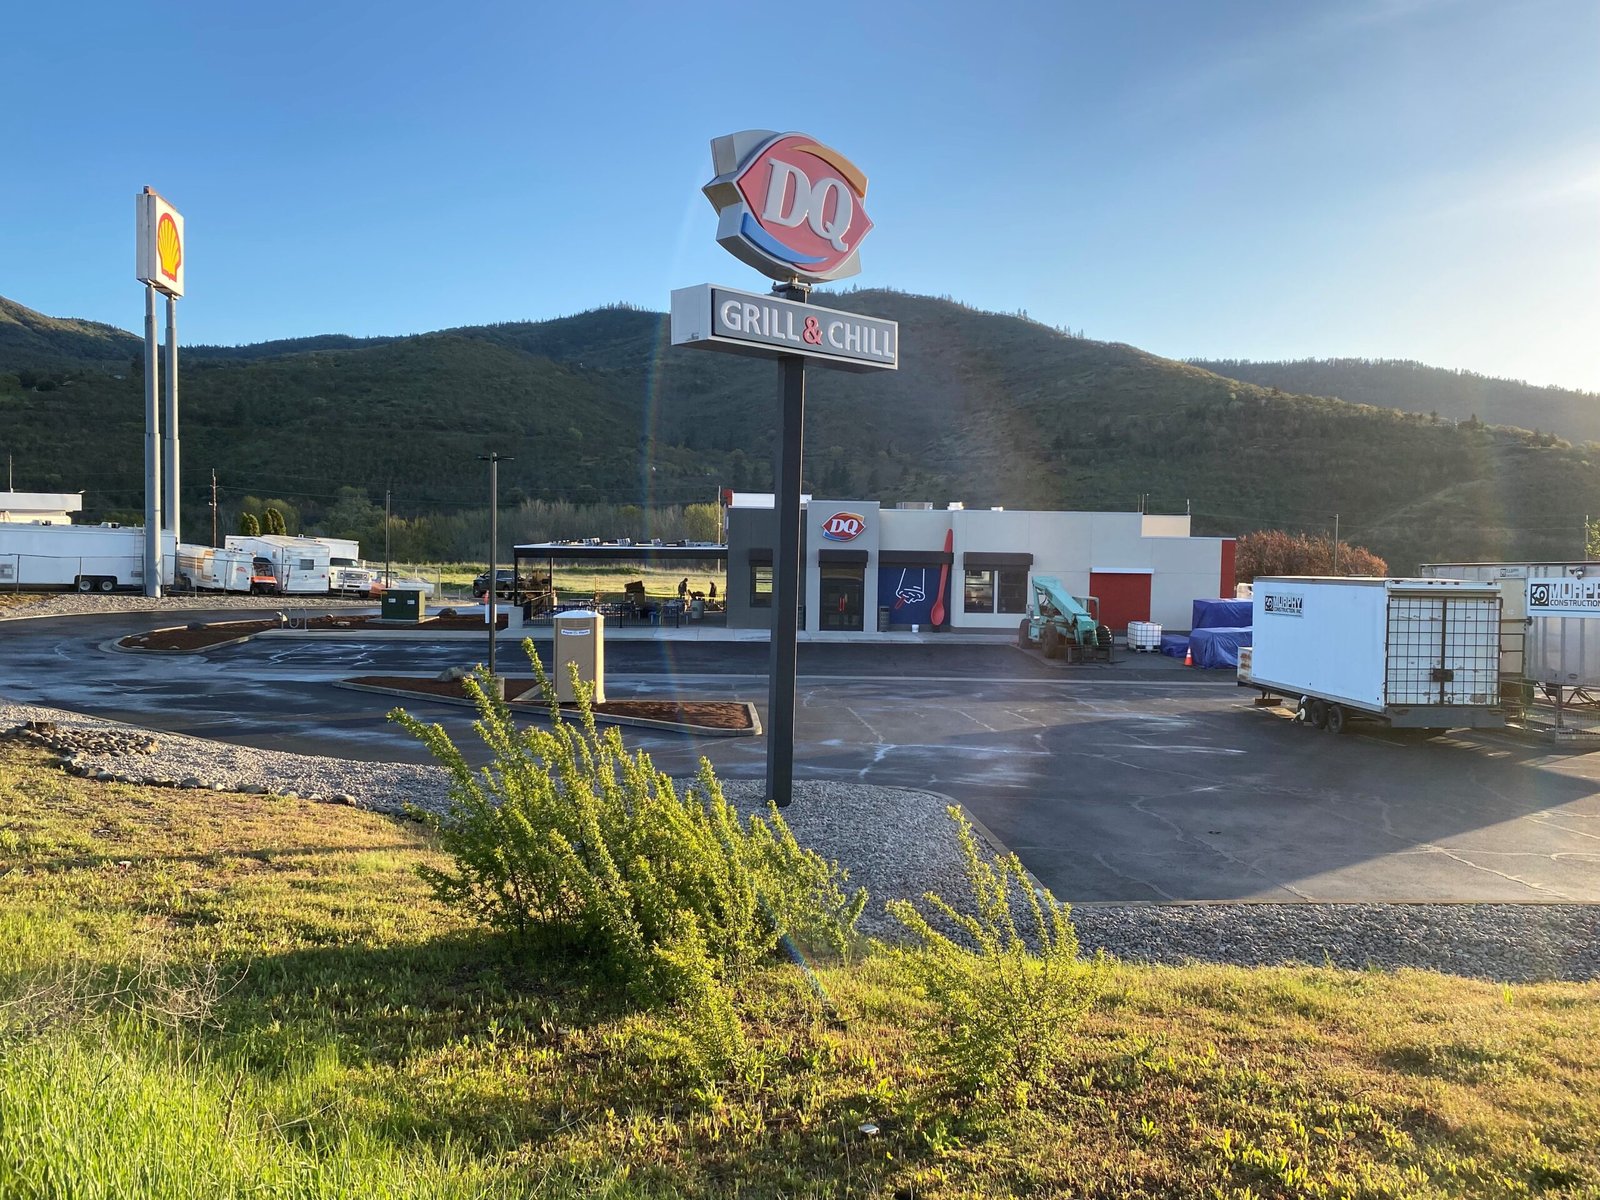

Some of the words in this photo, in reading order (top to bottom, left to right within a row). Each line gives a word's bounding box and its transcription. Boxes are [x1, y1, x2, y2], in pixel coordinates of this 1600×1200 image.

[761, 157, 853, 252] DQ
[720, 300, 800, 342] GRILL
[802, 315, 823, 346] &
[827, 321, 895, 358] CHILL
[830, 518, 859, 535] DQ
[1274, 596, 1302, 608] MURPHY
